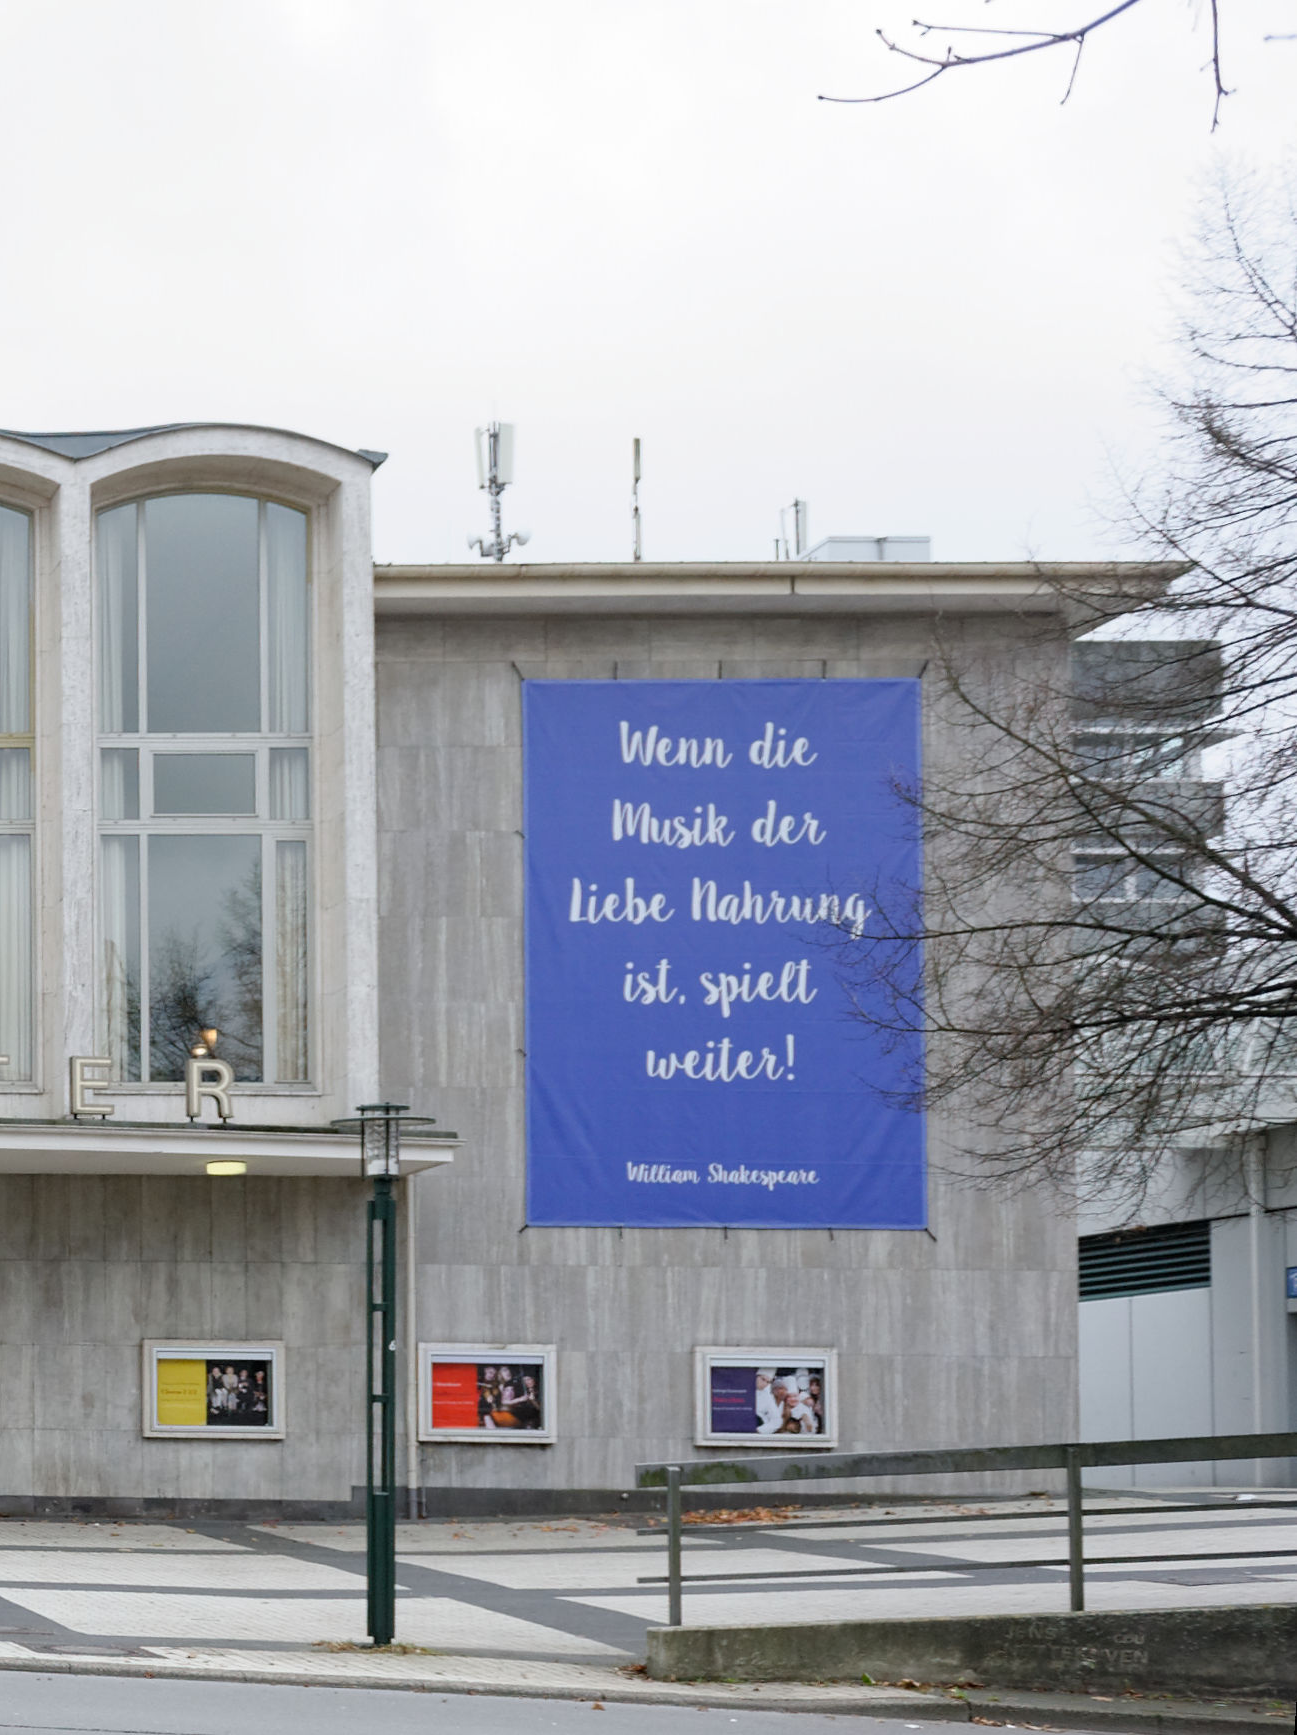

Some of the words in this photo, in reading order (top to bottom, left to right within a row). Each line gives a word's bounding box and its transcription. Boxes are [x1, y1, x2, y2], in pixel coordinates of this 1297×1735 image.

[619, 720, 733, 768] Wenn
[748, 721, 818, 768] die
[611, 799, 735, 849] Musik
[751, 799, 826, 846] der
[568, 877, 675, 925] Liebe
[691, 877, 872, 941] Nahrung
[700, 958, 818, 1018] spielt
[645, 1034, 797, 1082] weiter!
[626, 1161, 700, 1185] William
[706, 1163, 820, 1191] Shakespeare
